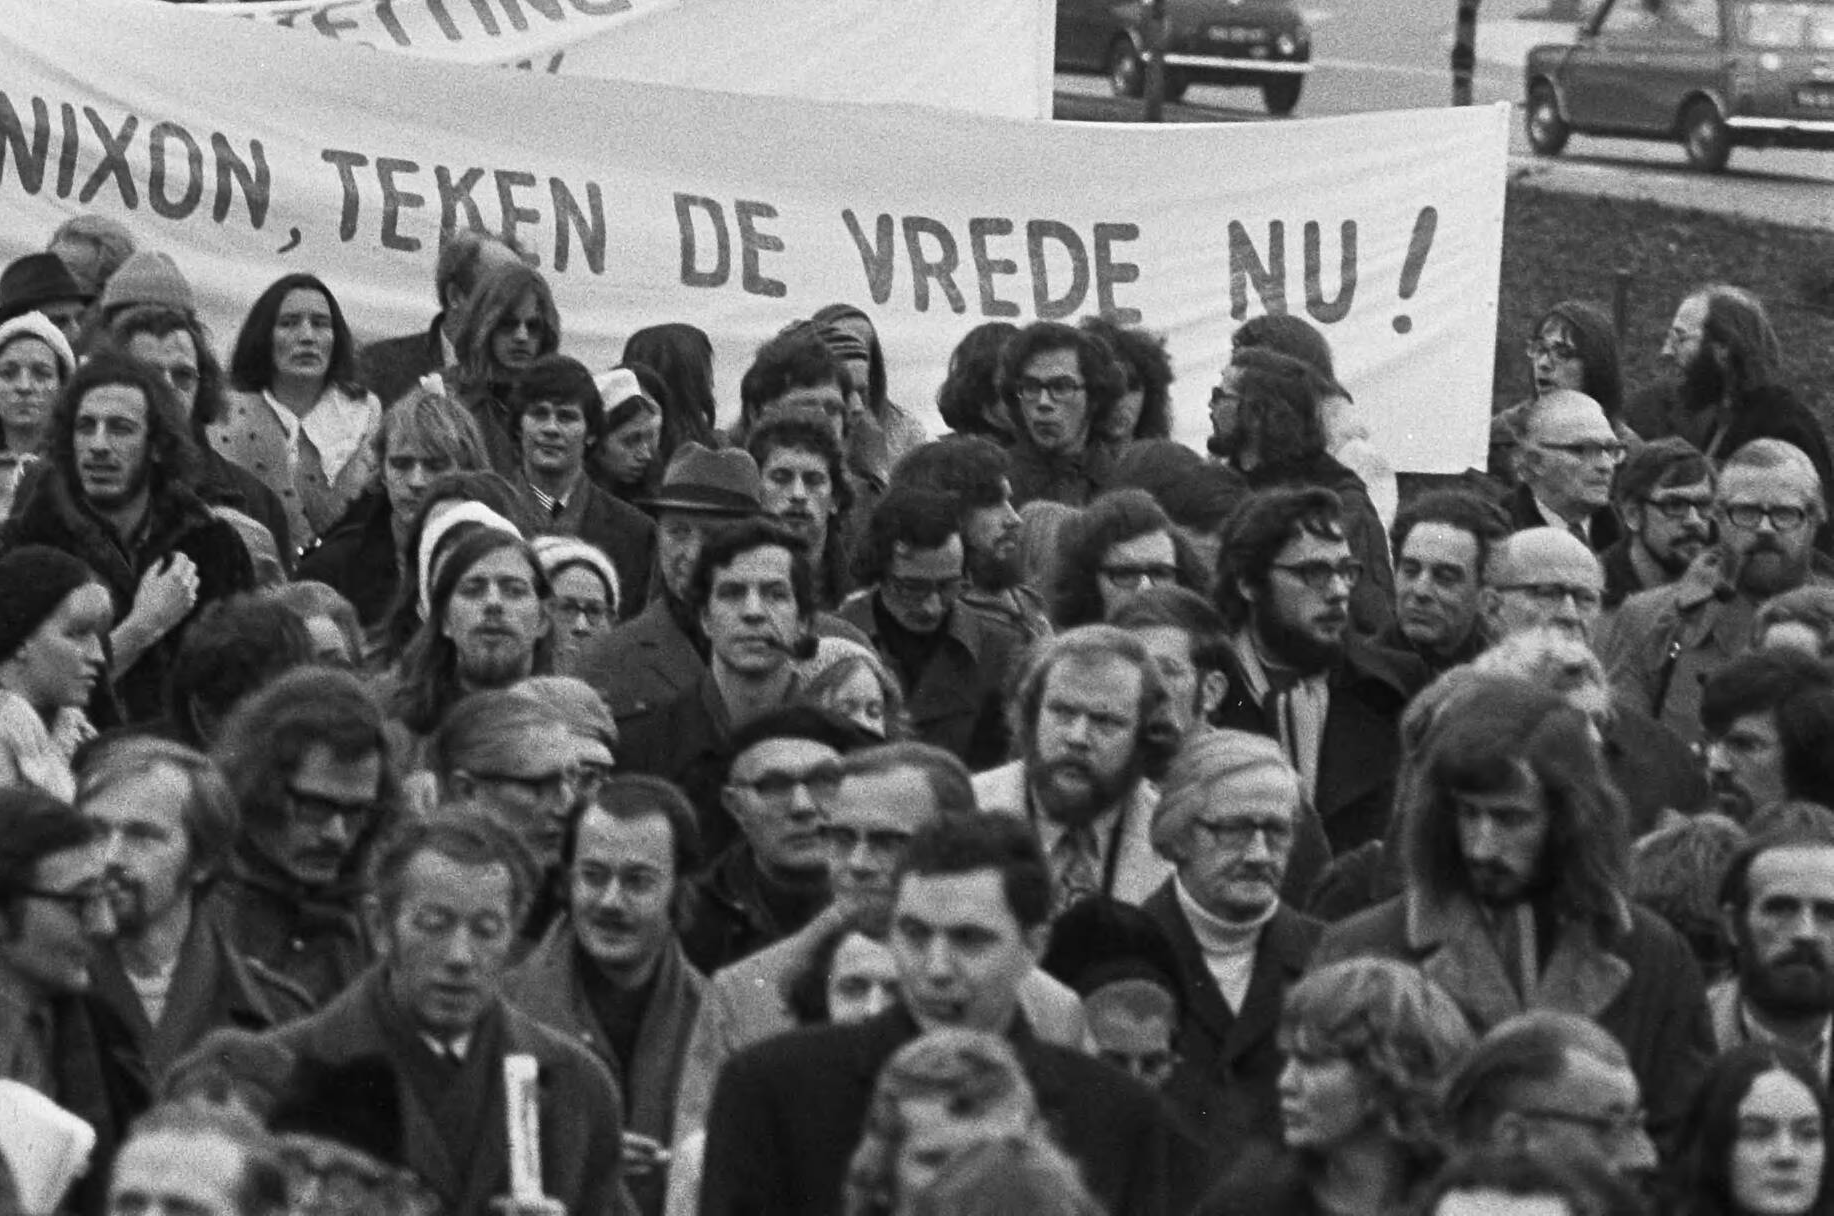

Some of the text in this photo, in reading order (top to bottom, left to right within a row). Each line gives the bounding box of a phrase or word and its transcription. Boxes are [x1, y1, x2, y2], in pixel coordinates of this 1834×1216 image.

[321, 147, 608, 276] TEKEN
[672, 192, 788, 298] DE
[841, 205, 1143, 324] VREDE
